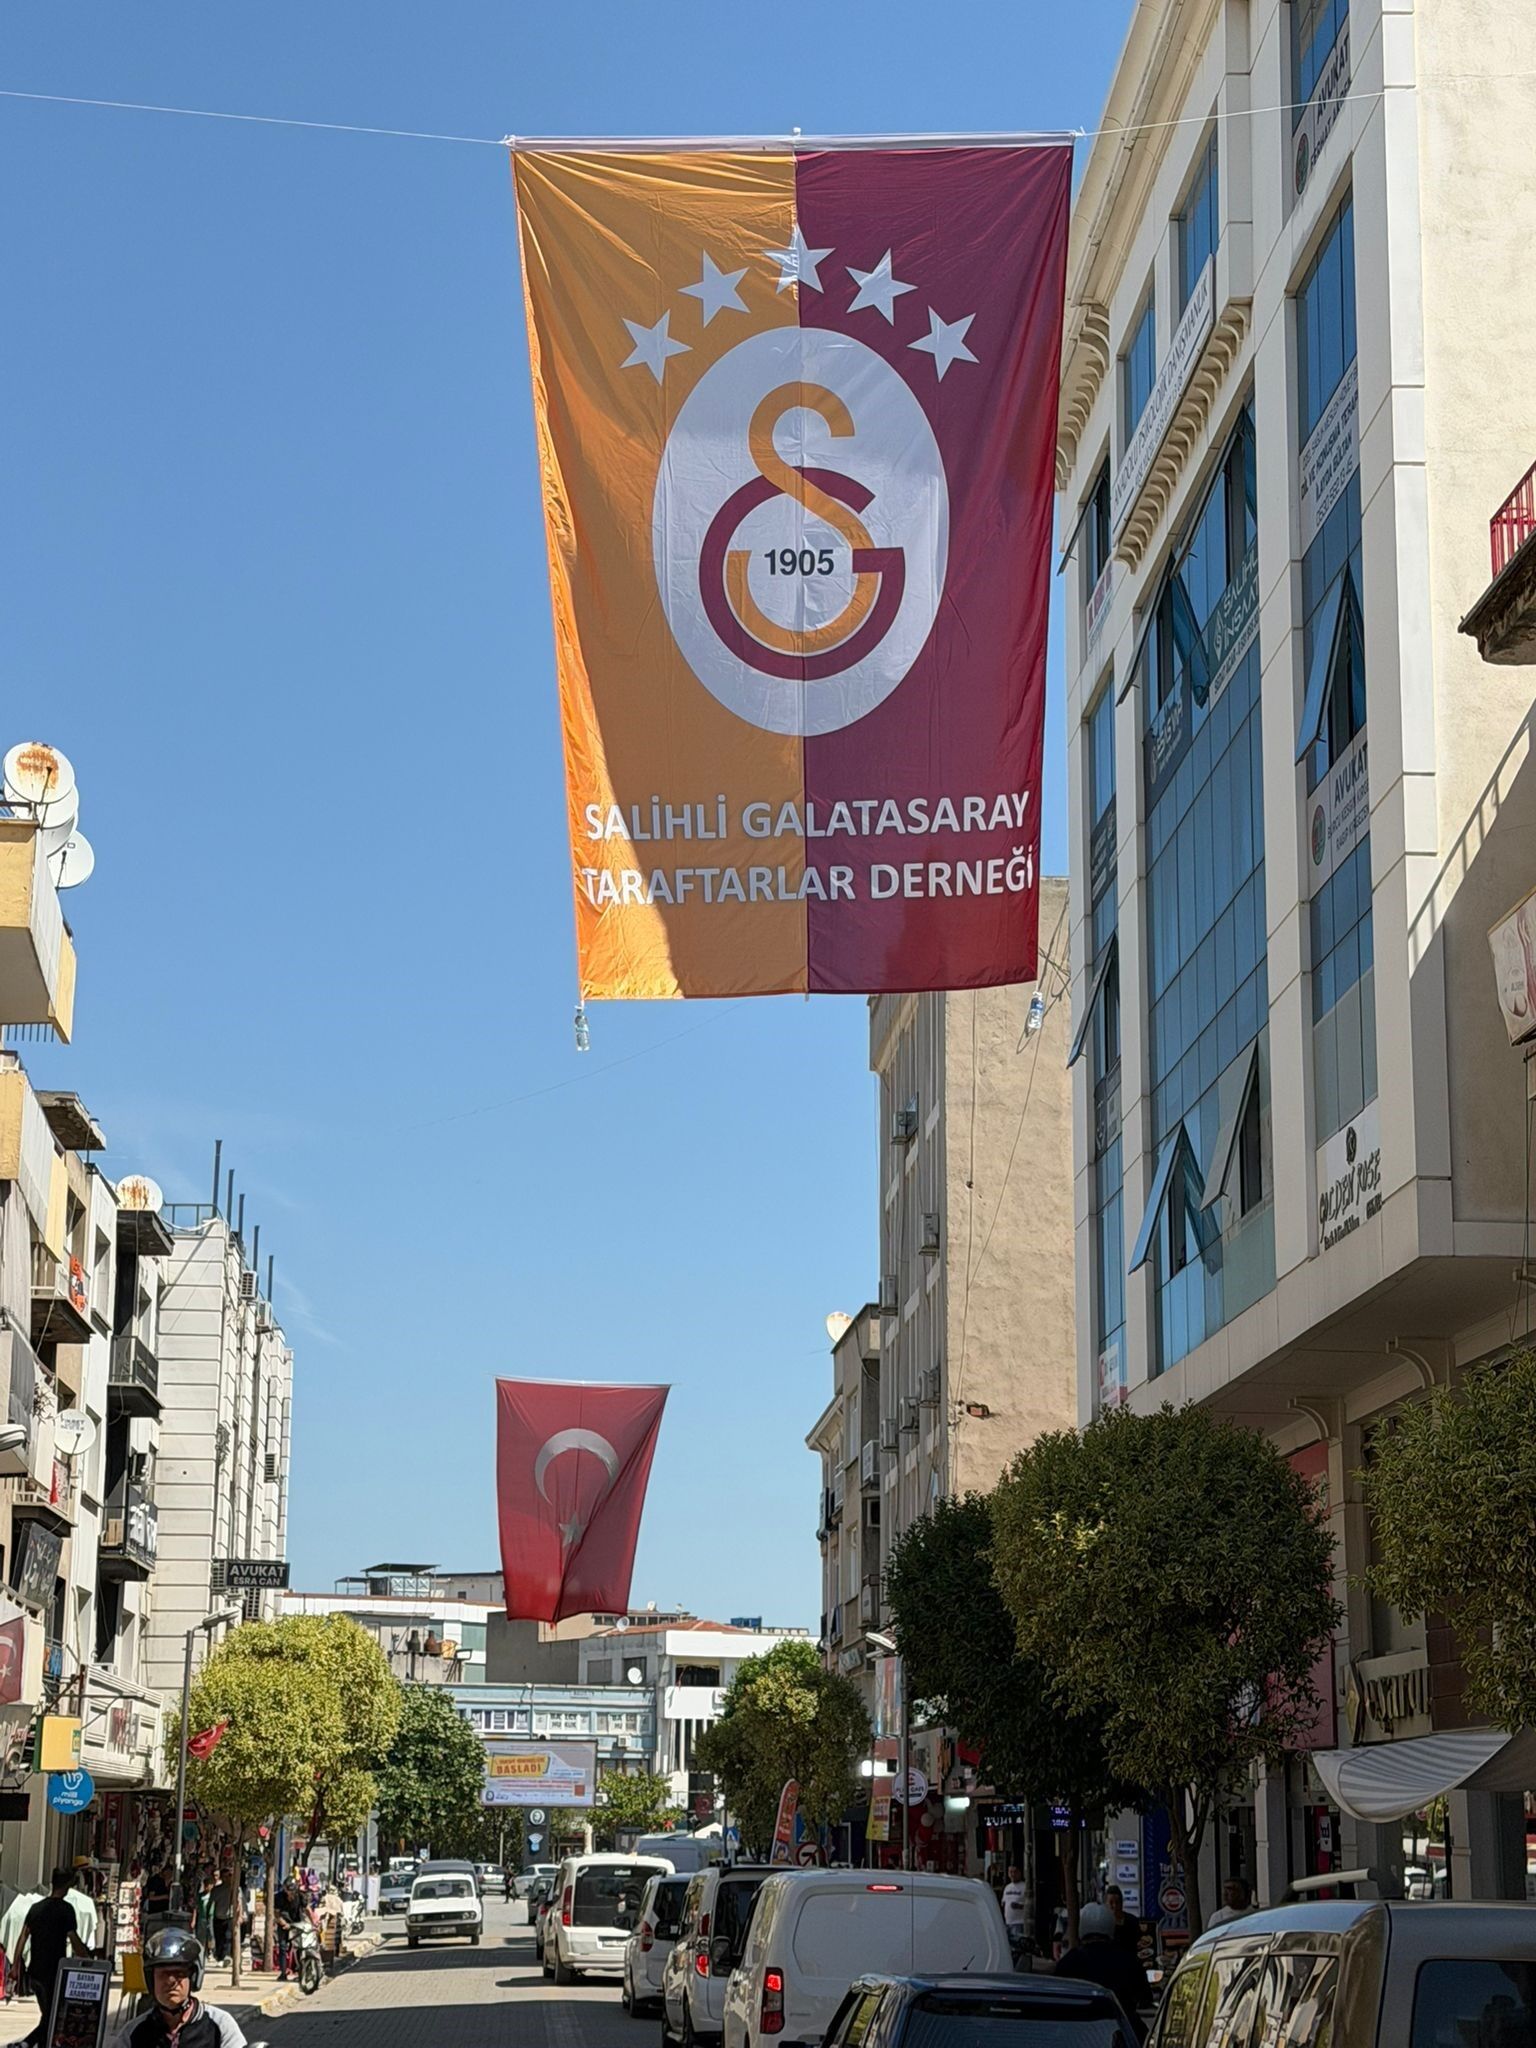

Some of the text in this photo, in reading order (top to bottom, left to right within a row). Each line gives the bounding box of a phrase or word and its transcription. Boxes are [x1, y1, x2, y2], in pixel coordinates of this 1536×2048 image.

[1317, 31, 1349, 125] AVUKAT
[764, 549, 834, 576] 1905
[1334, 741, 1367, 808] AVUKAT
[585, 791, 1030, 841] SALİHLİ GALATASARAY
[581, 846, 1033, 905] TARAFTARLAR DERNEĞİ
[230, 1565, 286, 1577] AVUKAT
[233, 1576, 280, 1586] ESRA CAN
